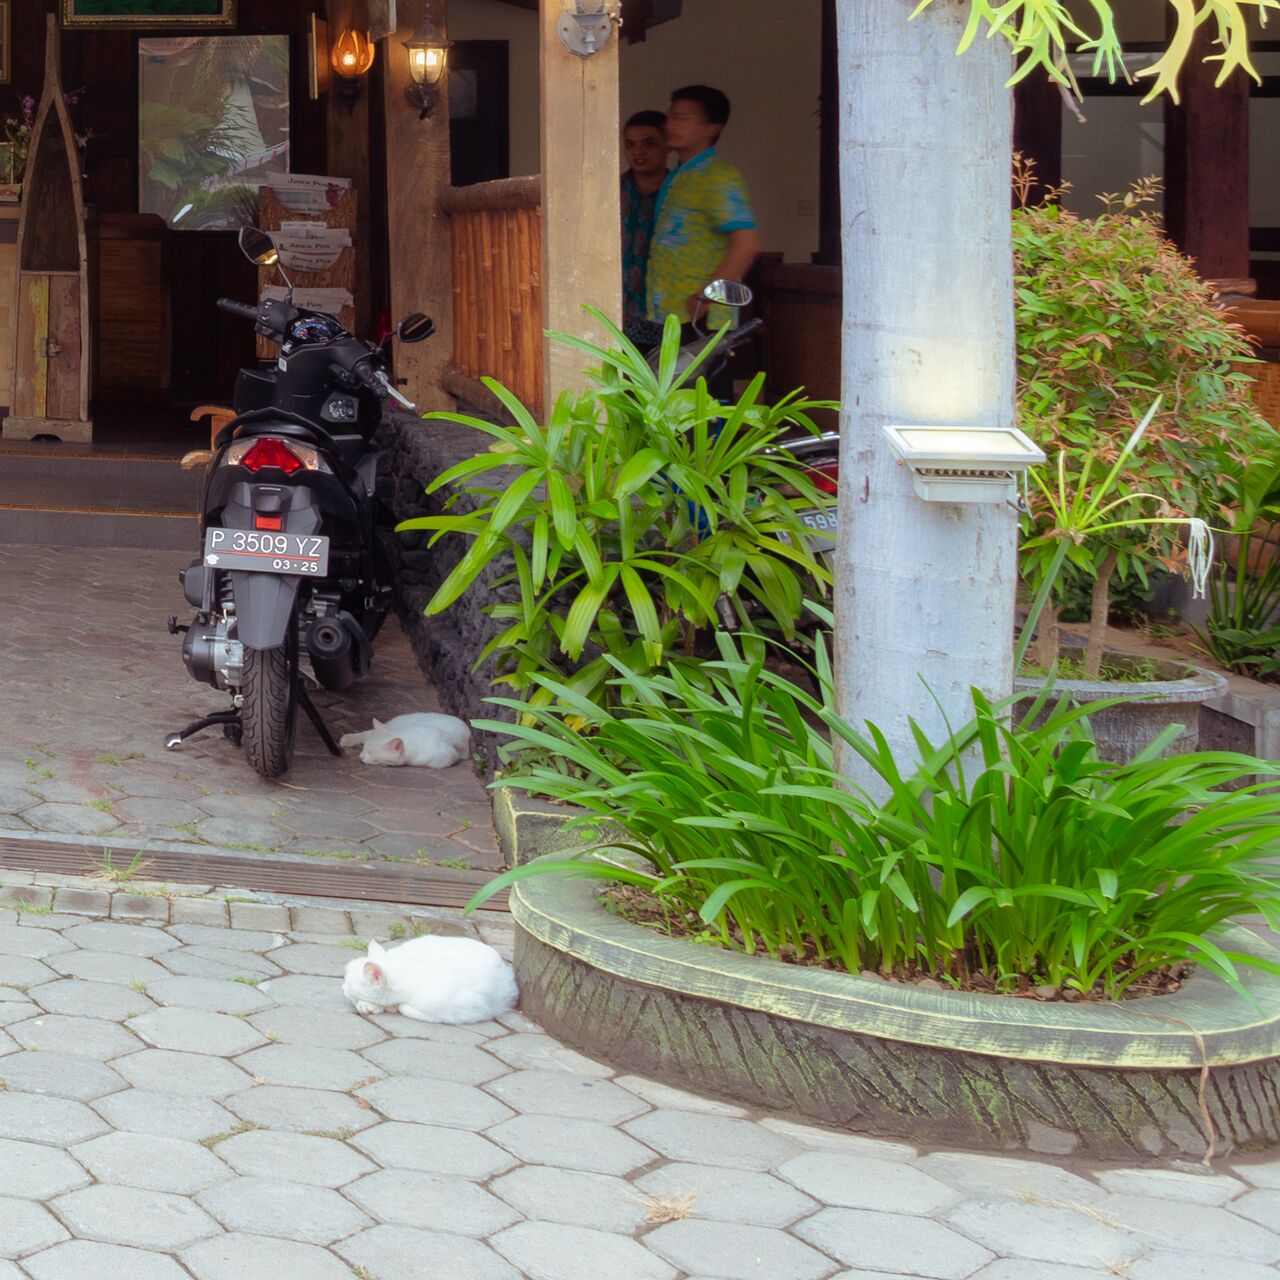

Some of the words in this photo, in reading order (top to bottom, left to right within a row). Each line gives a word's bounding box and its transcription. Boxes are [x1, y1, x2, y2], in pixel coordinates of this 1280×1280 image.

[211, 530, 225, 548] P
[232, 532, 288, 554] 3509
[295, 537, 322, 557] YZ
